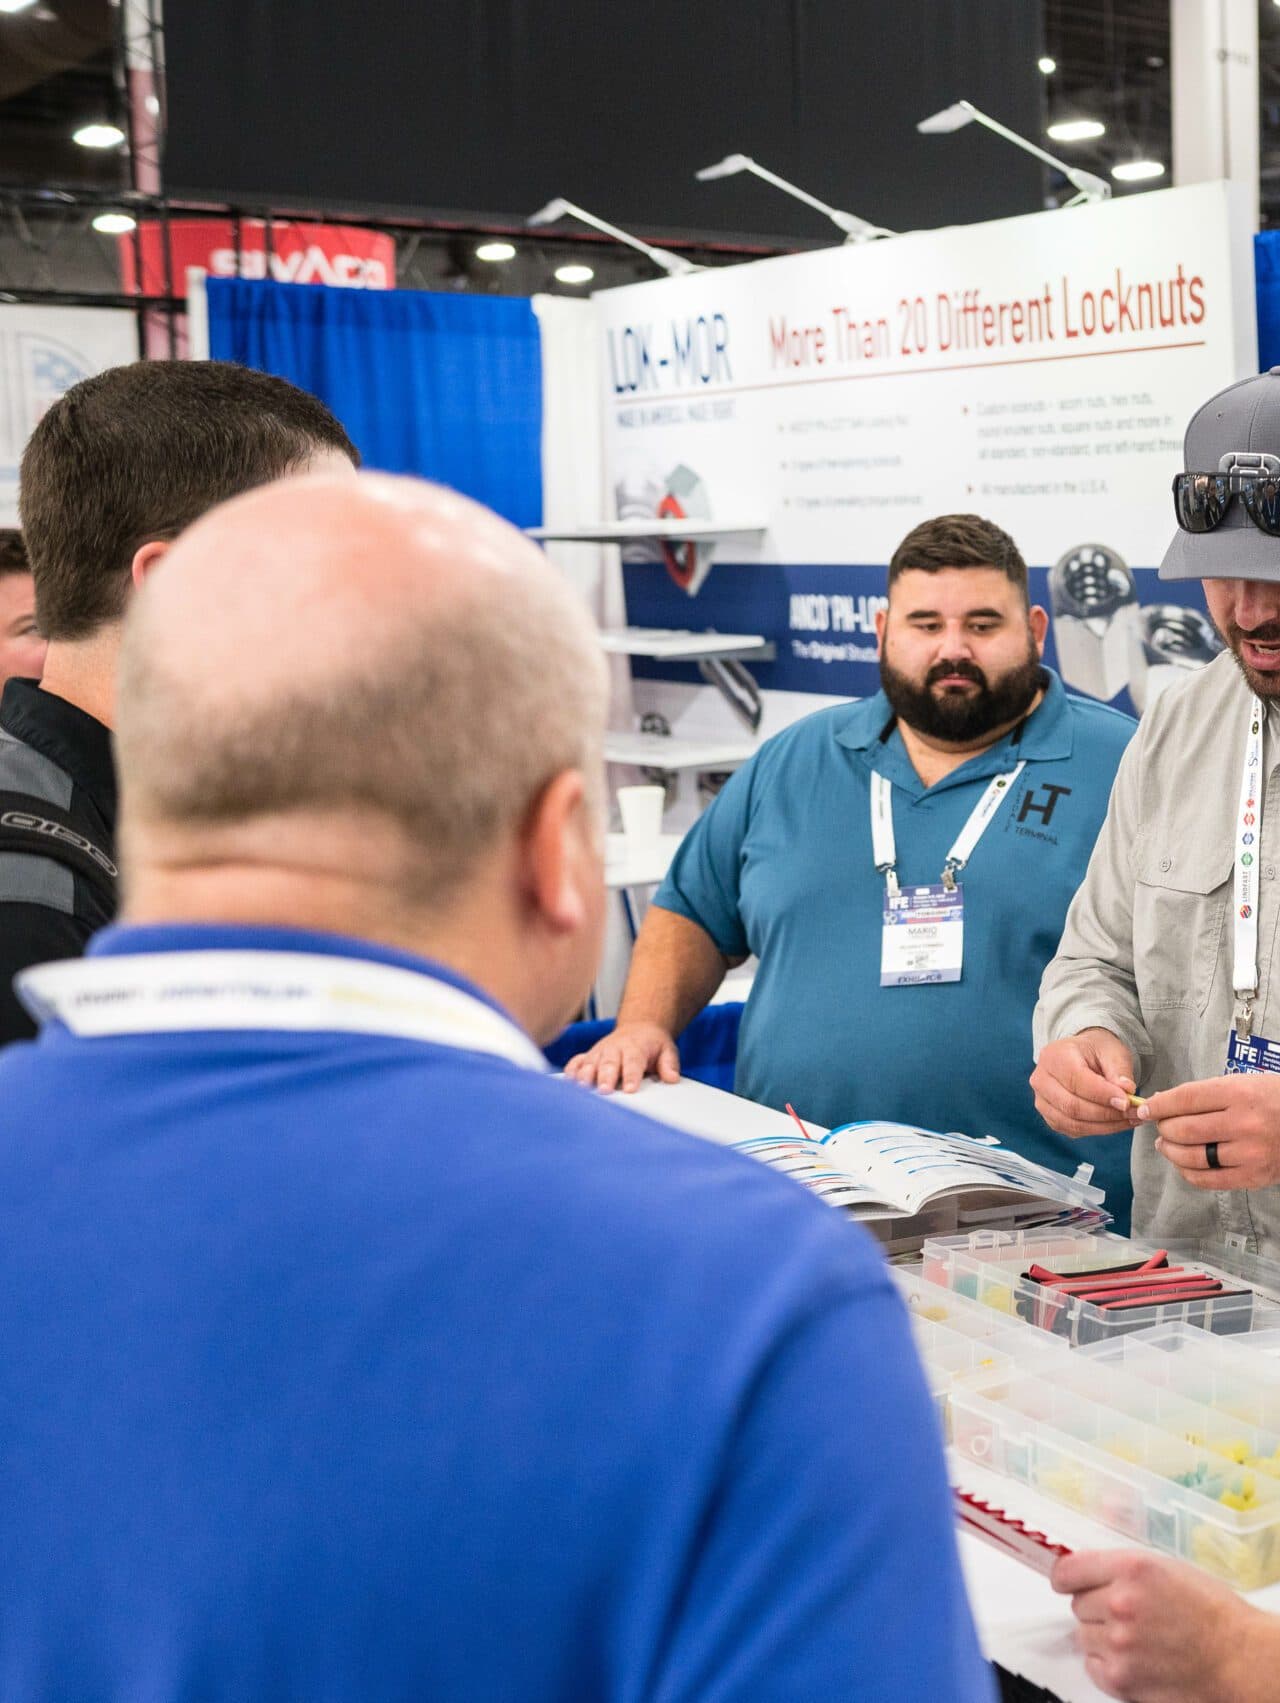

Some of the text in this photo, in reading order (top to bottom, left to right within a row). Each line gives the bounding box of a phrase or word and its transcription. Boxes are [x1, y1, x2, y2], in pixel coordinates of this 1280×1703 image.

[769, 263, 1206, 369] More Than 20 Different Locknuts
[831, 594, 888, 633] PN-LO
[1235, 1043, 1258, 1063] IFE
